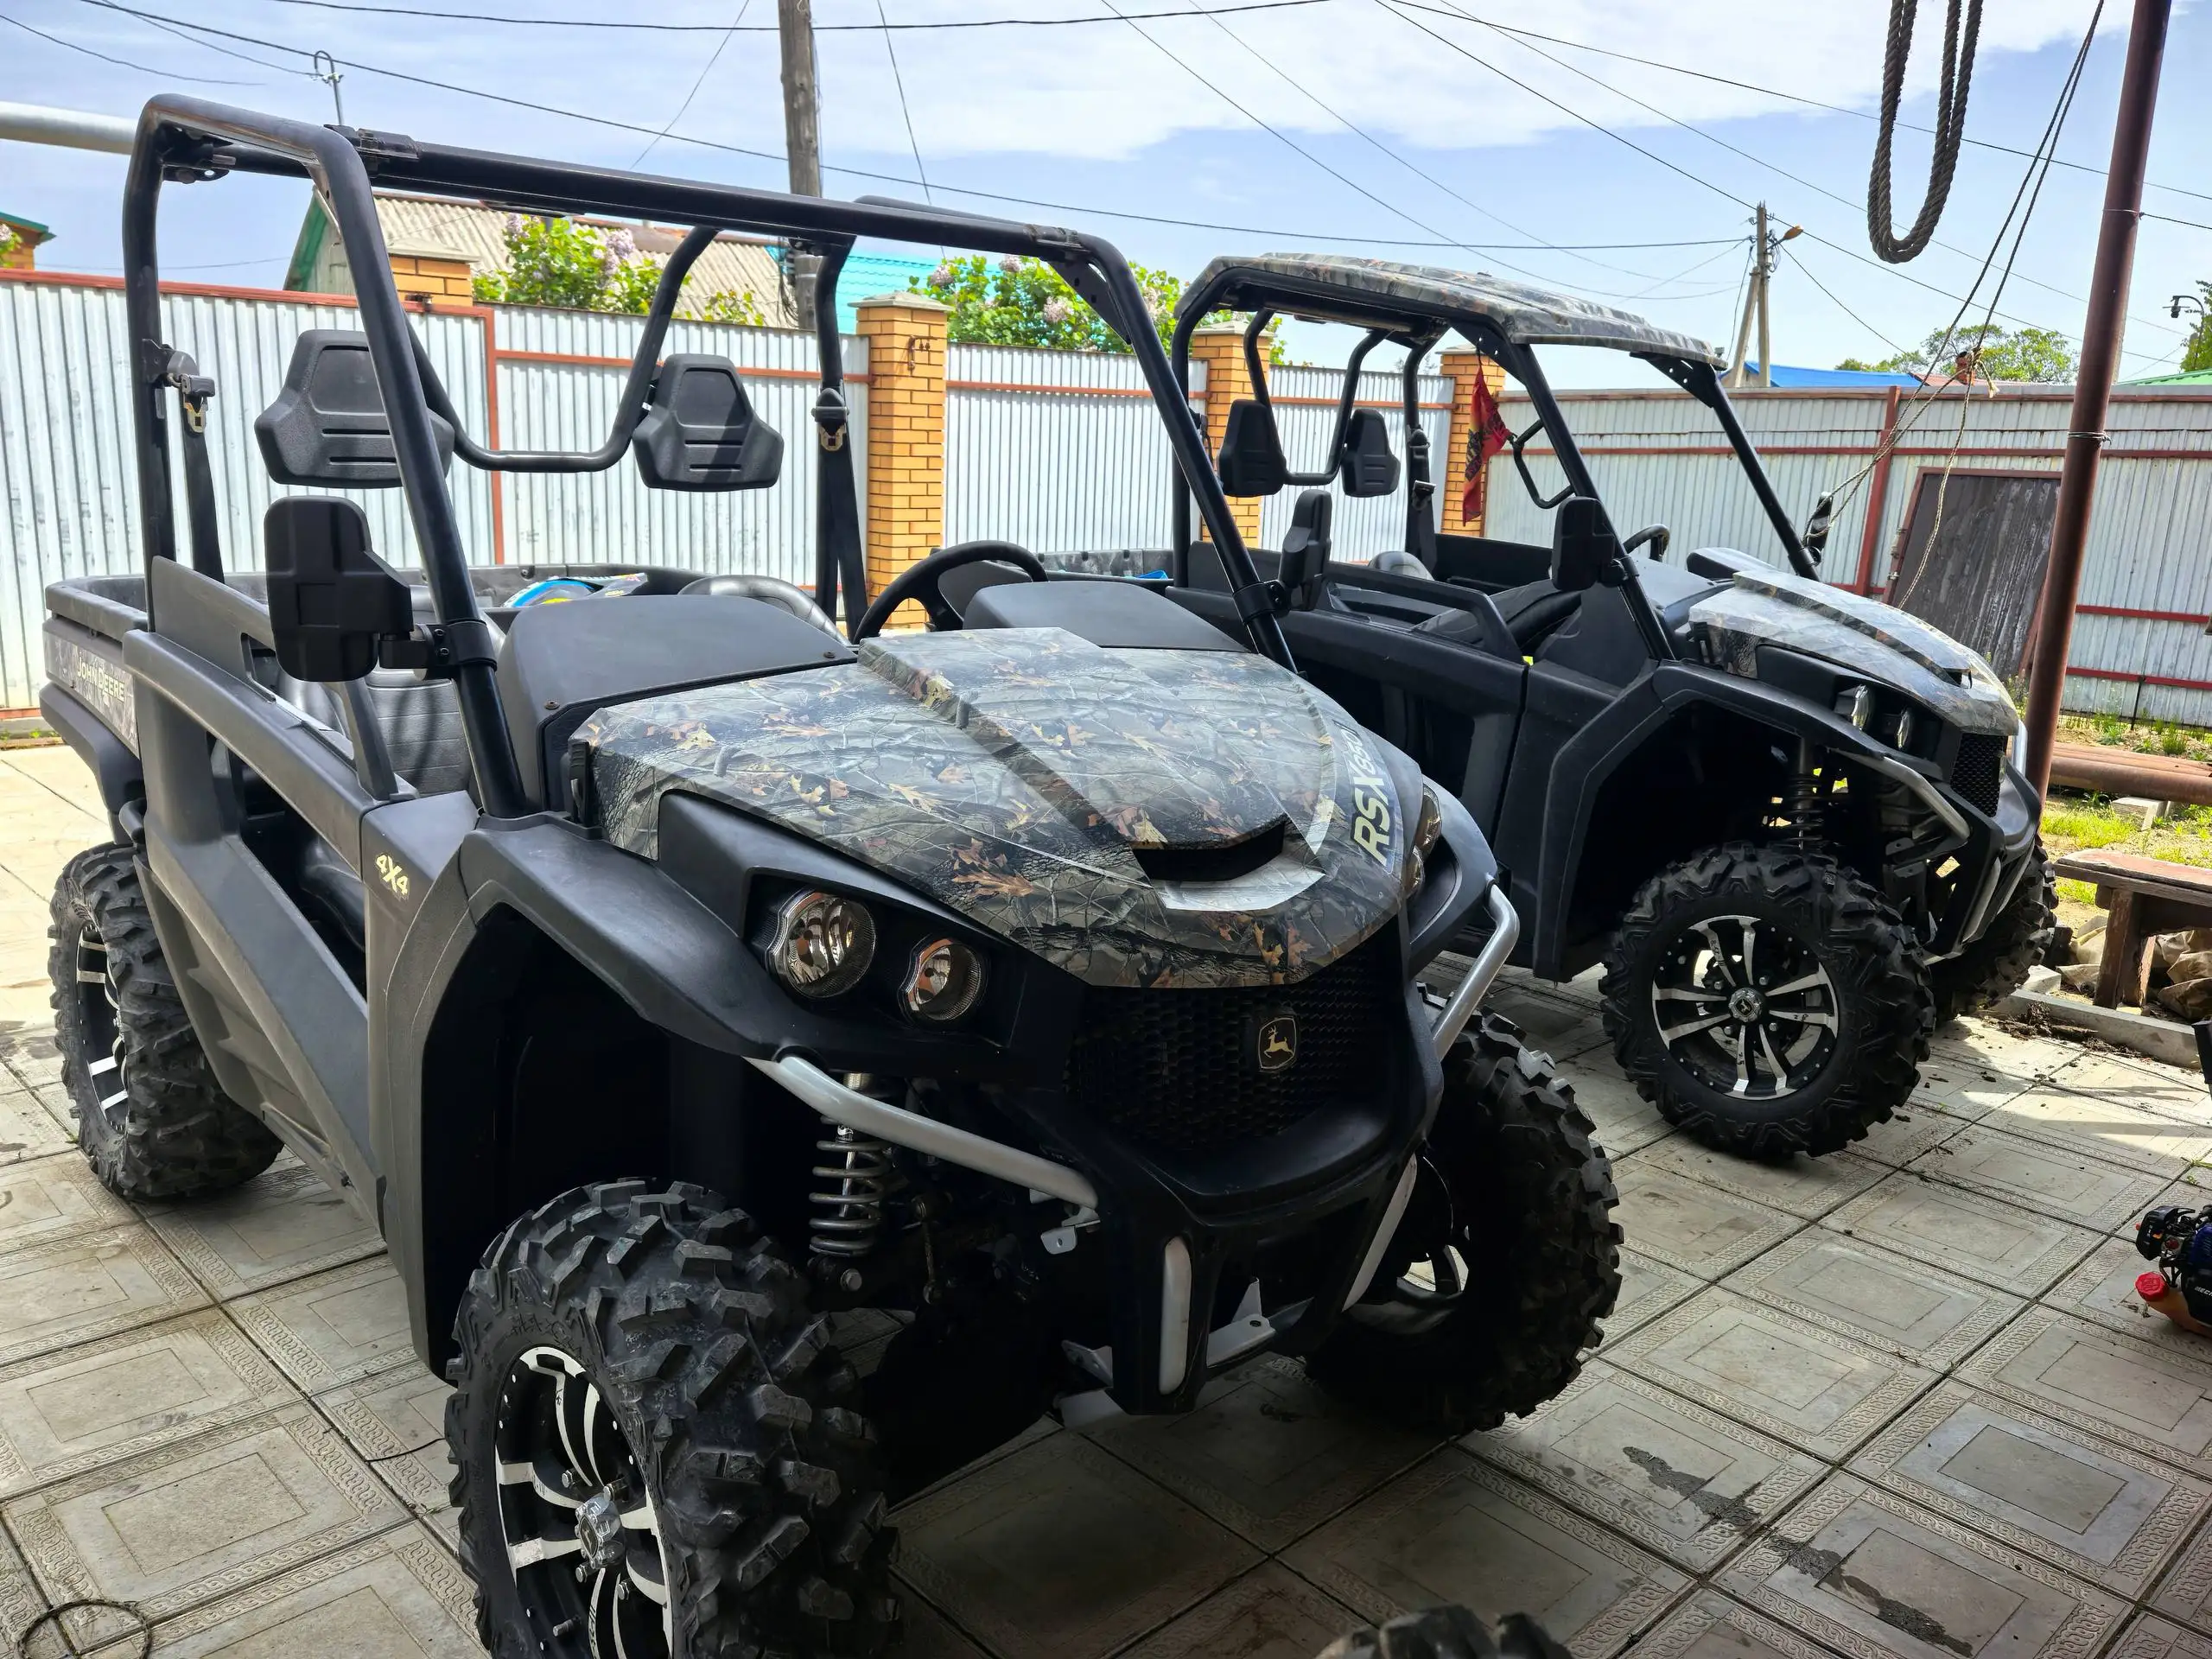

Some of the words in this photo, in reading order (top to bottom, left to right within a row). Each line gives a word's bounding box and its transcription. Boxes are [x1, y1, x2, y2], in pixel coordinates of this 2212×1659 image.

[77, 657, 99, 685] JOHN
[98, 667, 125, 702] DEERE
[1349, 760, 1390, 867] RSX
